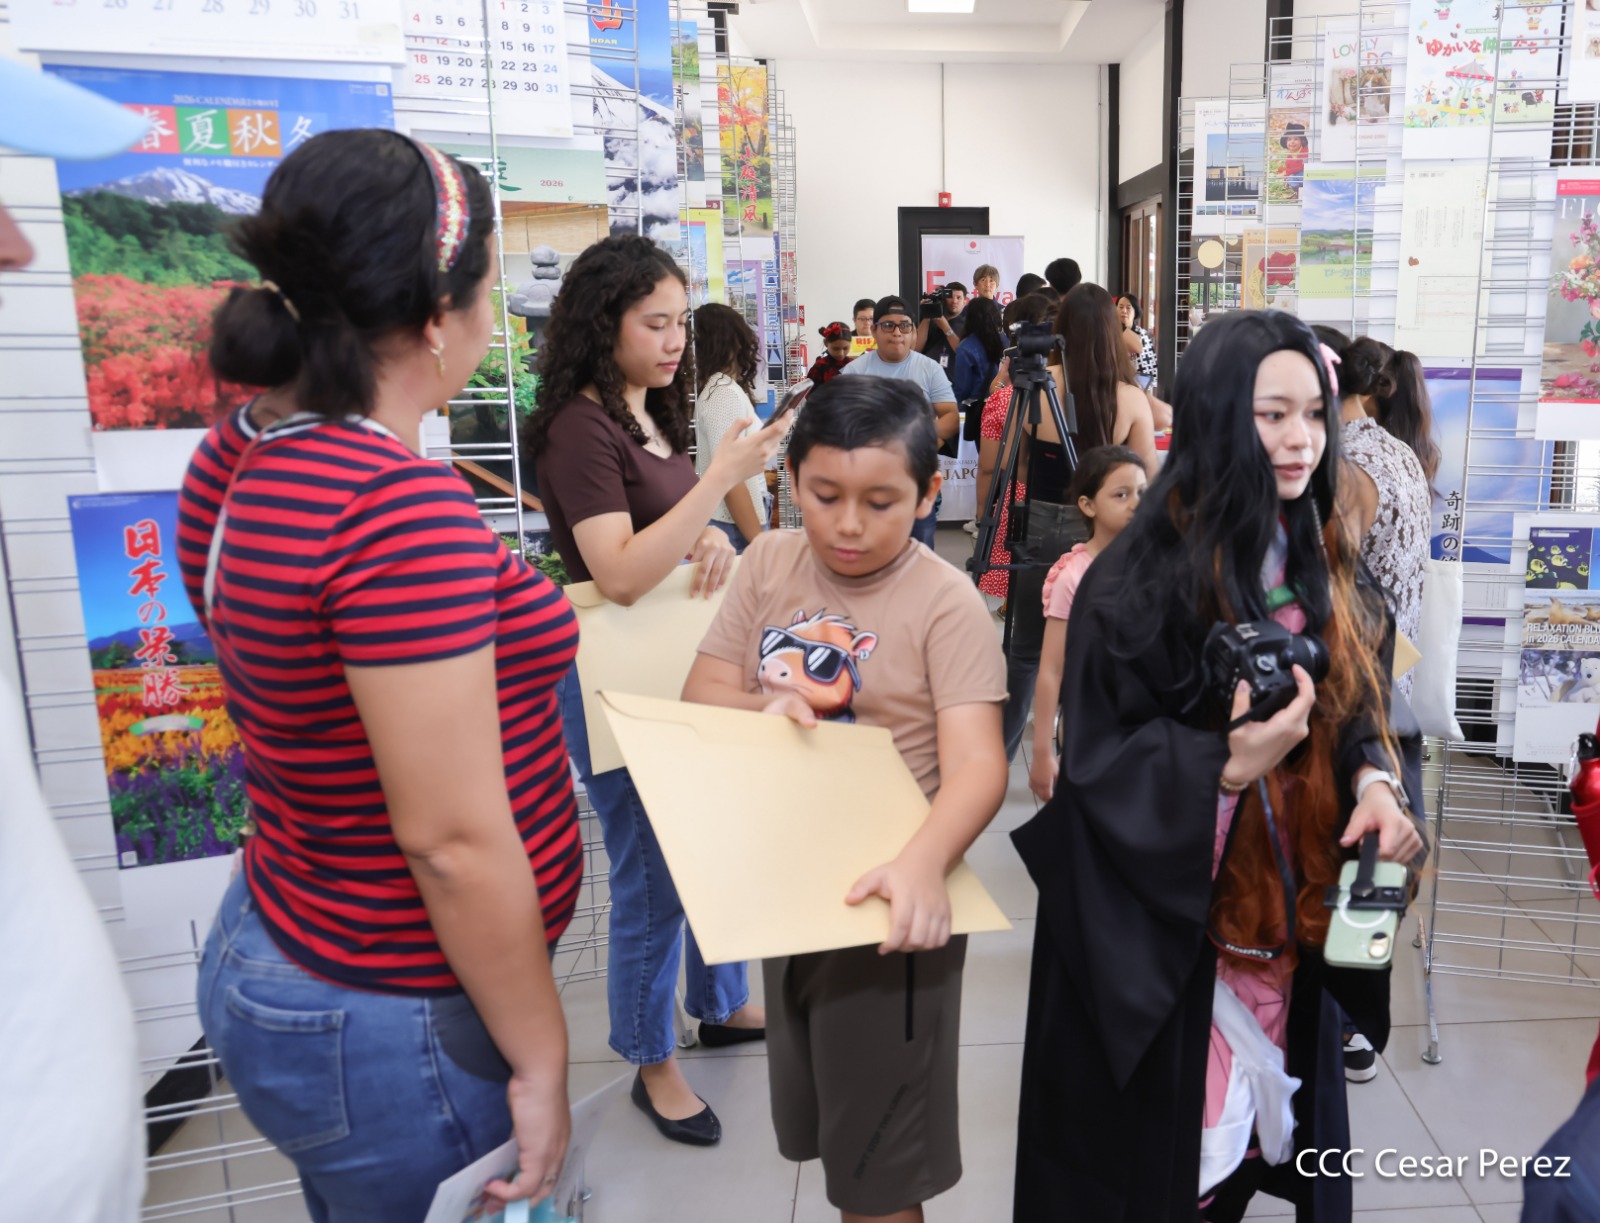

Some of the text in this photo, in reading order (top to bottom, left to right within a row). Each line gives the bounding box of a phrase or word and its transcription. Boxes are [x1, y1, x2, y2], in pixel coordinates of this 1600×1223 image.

[248, 0, 271, 16] 29
[295, 0, 318, 18] 30
[339, 1, 361, 19] 31
[521, 4, 529, 12] 2
[542, 6, 550, 14] 3
[413, 14, 555, 34] 4 5 6 8 9 10
[501, 41, 514, 51] 15
[522, 43, 535, 52] 16
[543, 44, 556, 53] 17
[414, 54, 428, 64] 18
[436, 56, 451, 65] 19
[458, 57, 473, 67] 20
[501, 61, 516, 71] 22
[522, 62, 538, 72] 23
[543, 64, 558, 73] 24
[415, 74, 430, 84] 25
[437, 76, 453, 86] 26
[459, 77, 474, 87] 27
[502, 80, 518, 90] 29
[524, 82, 539, 92] 30
[546, 83, 559, 93] 31
[540, 179, 564, 187] 2026
[1441, 490, 1463, 562] 奇跡の
[124, 518, 190, 708] 日本の景勝
[1527, 622, 1582, 634] RELAXATION
[1536, 634, 1559, 644] 2026
